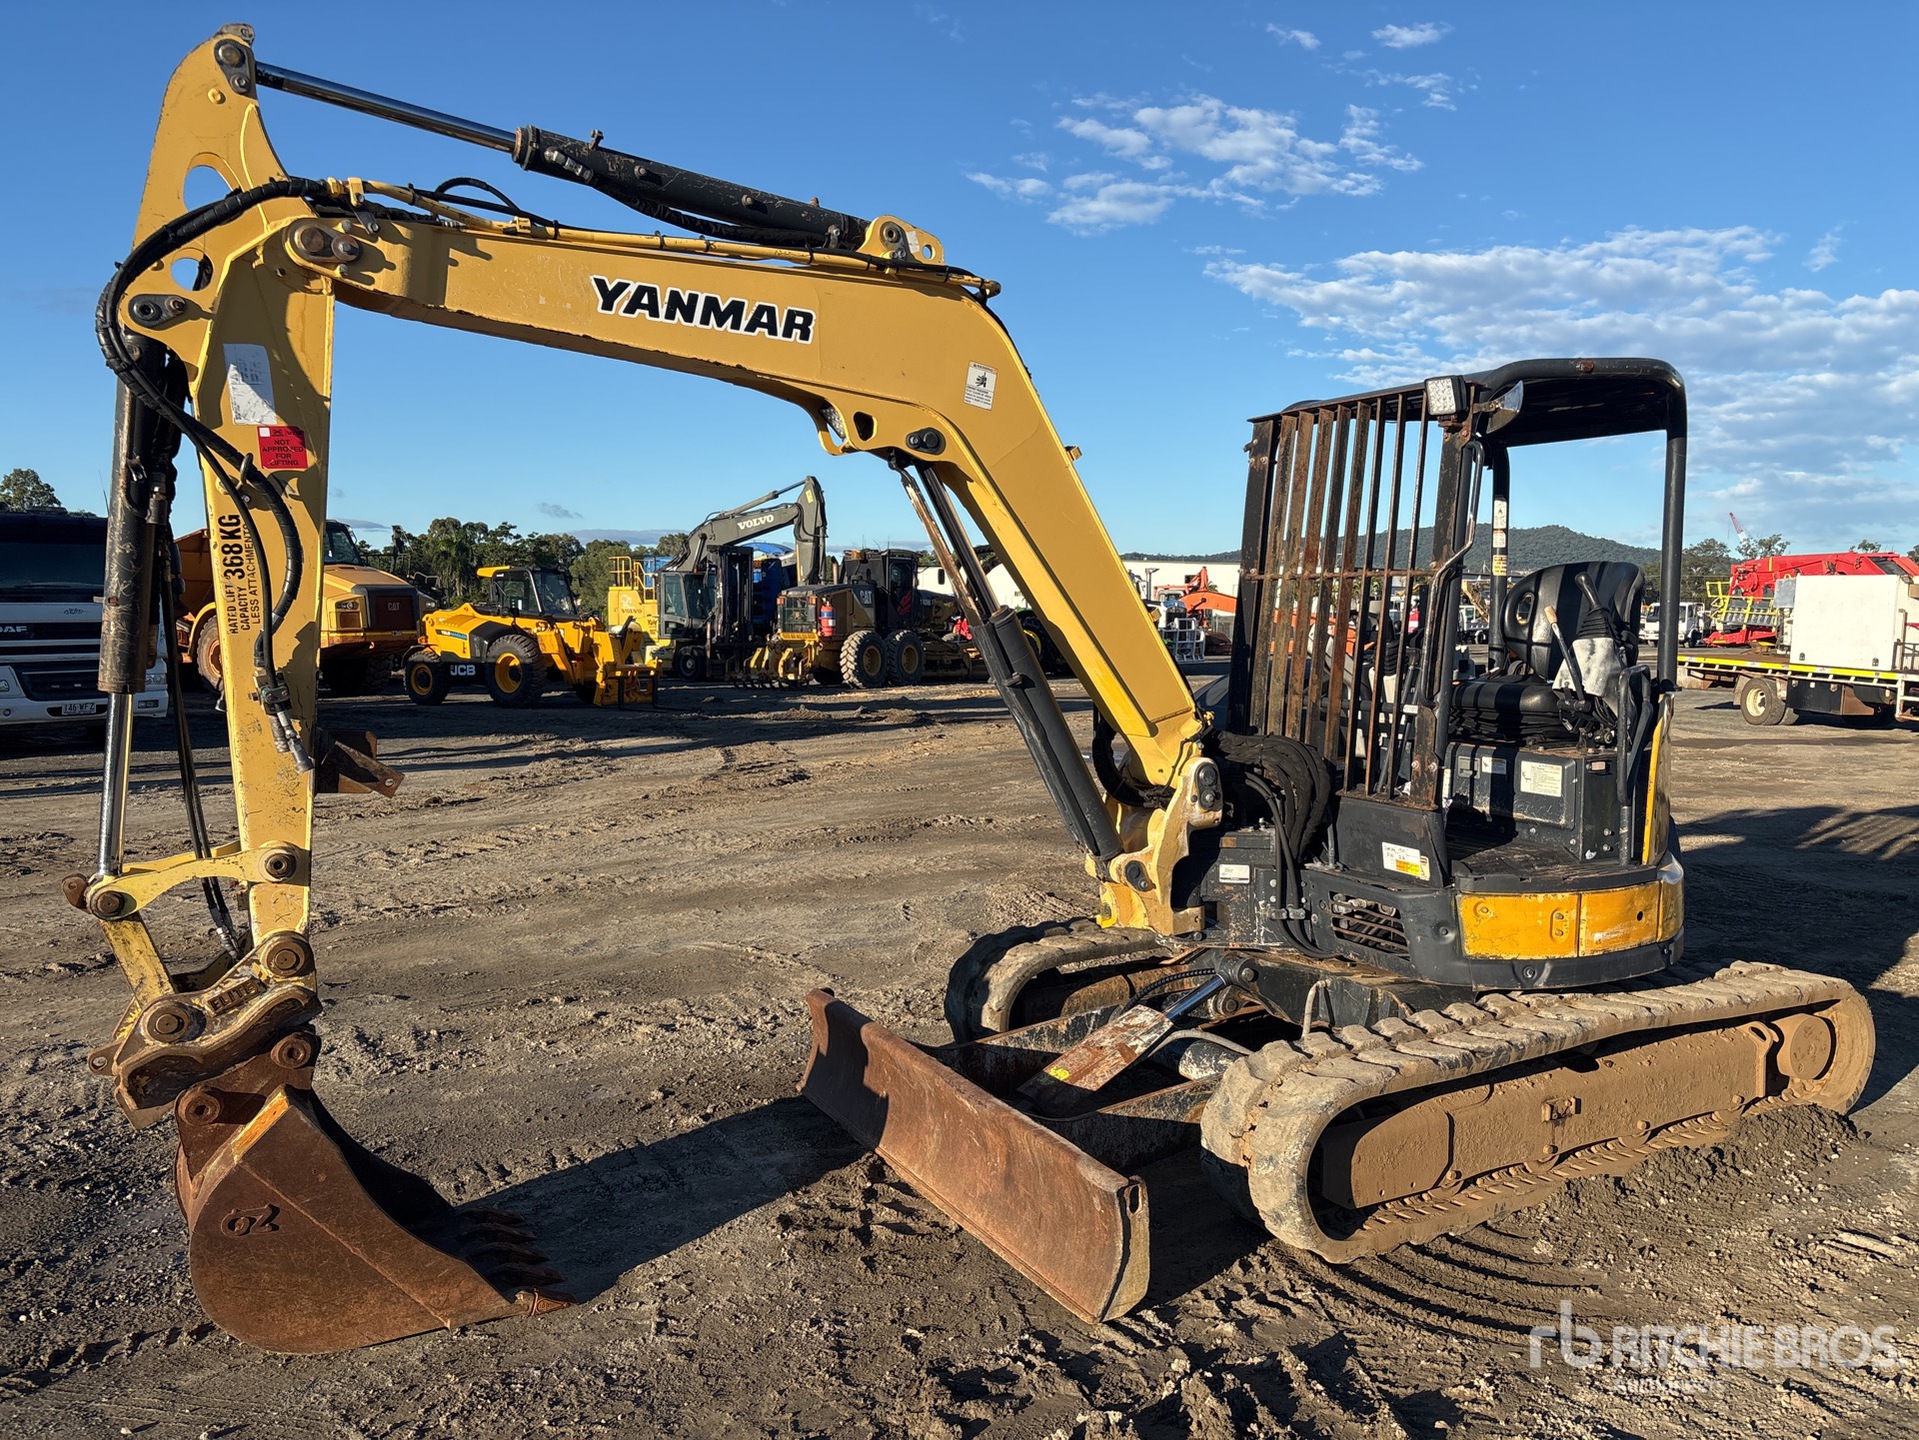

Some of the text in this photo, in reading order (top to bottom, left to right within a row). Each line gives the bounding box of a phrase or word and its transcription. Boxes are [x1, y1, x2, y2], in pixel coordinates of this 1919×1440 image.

[592, 275, 816, 343] YANMAR
[737, 514, 774, 530] VOLVO
[218, 514, 245, 580] 368 KG
[243, 524, 260, 624] LESS ATTACHMENT
[225, 584, 238, 634] RATED LIFT
[237, 586, 250, 630] CAPACITY
[387, 602, 400, 611] CAT
[859, 590, 872, 604] CAT
[0, 625, 27, 633] AF
[450, 664, 476, 676] JCB
